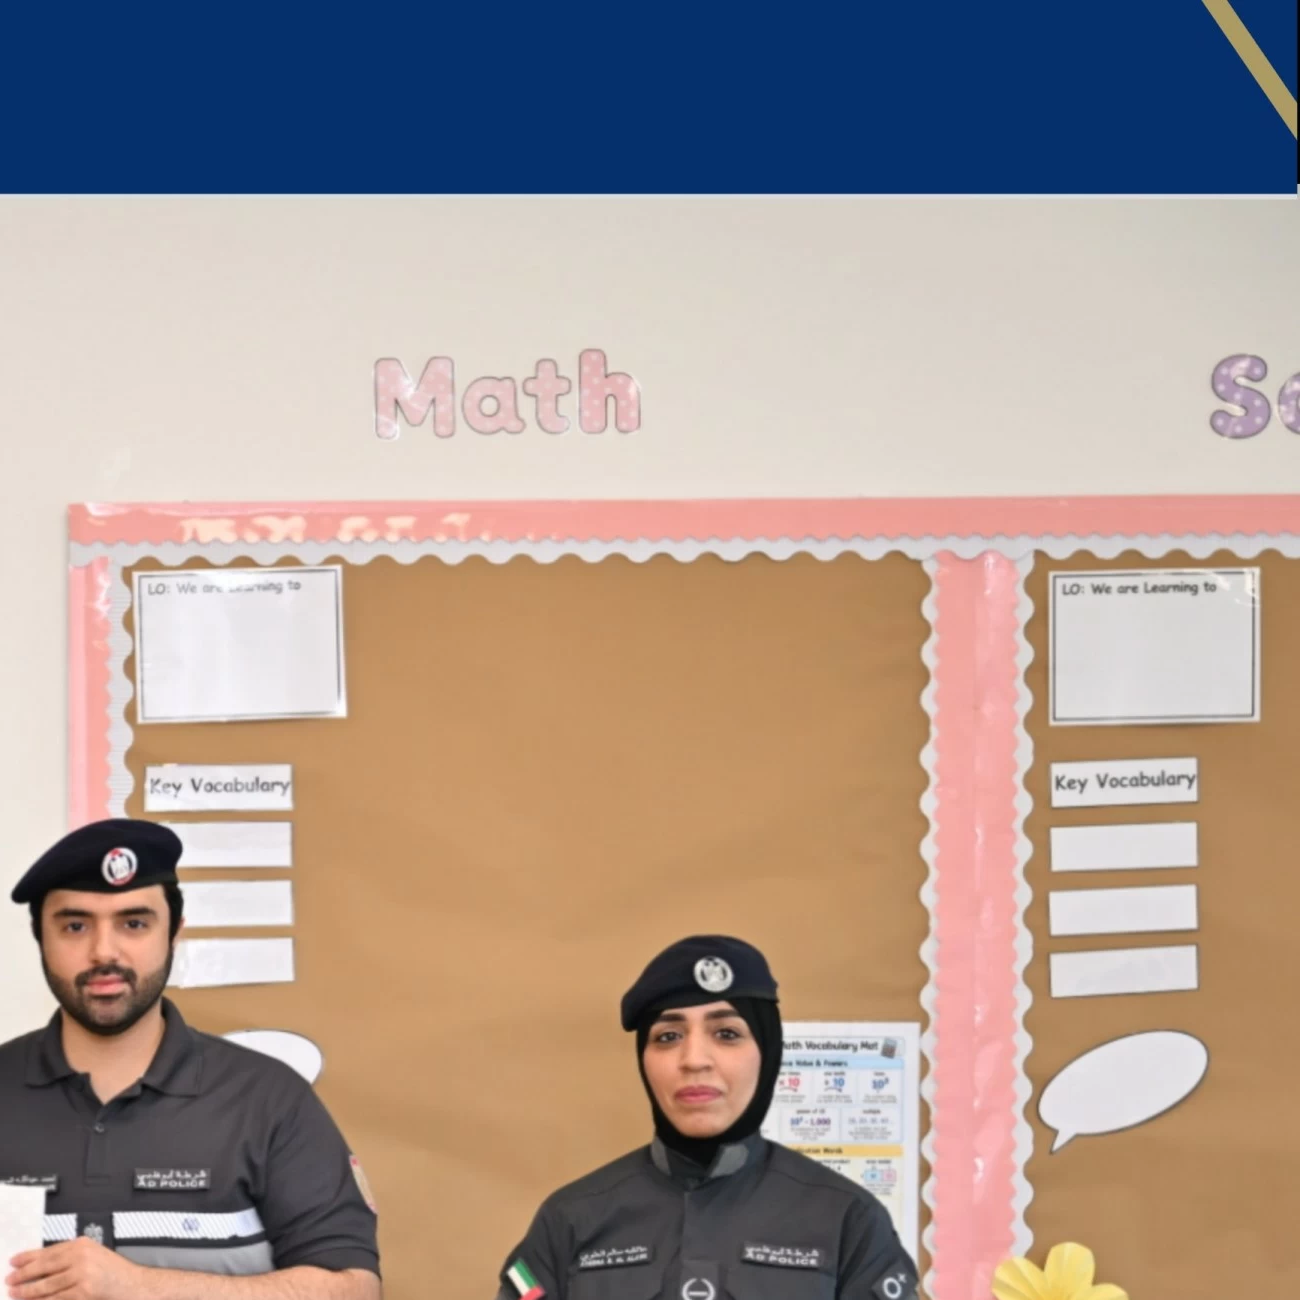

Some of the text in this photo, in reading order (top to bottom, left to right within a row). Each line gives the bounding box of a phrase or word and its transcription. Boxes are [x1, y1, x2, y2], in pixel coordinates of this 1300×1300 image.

[374, 348, 641, 439] Math
[176, 583, 198, 594] We
[288, 580, 301, 590] to
[1062, 581, 1217, 596] LO: We are Learning to
[150, 776, 290, 797] Key Vocabulary
[1055, 770, 1196, 795] Key Vocabulary
[805, 1041, 858, 1053] Vocabulary
[860, 1041, 878, 1050] Mat
[160, 1180, 206, 1188] POLICE
[769, 1255, 818, 1267] POLICE
